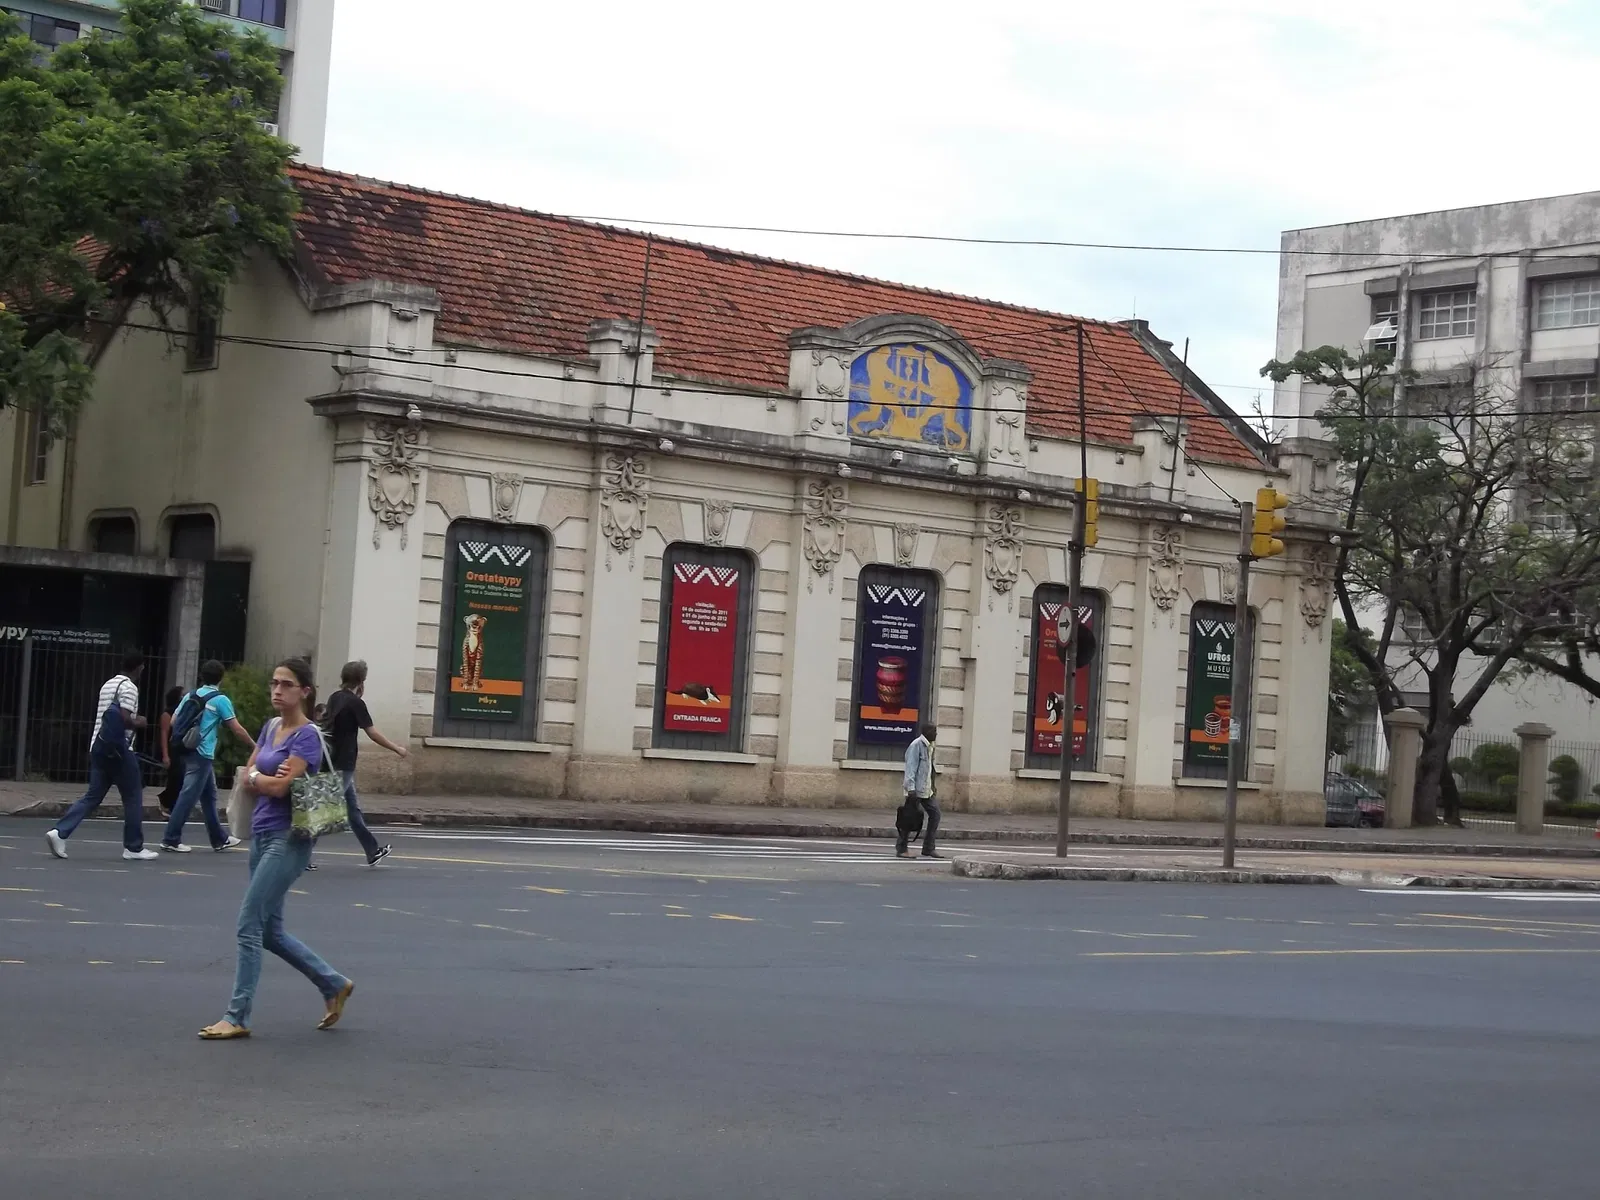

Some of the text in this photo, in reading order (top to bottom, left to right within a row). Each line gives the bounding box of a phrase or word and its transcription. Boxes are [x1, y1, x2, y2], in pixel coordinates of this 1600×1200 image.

[466, 571, 522, 587] Oretataypy
[1207, 652, 1231, 662] UFRGS
[1207, 664, 1230, 673] MUSEU
[673, 714, 722, 723] ENTRADA FRANCA
